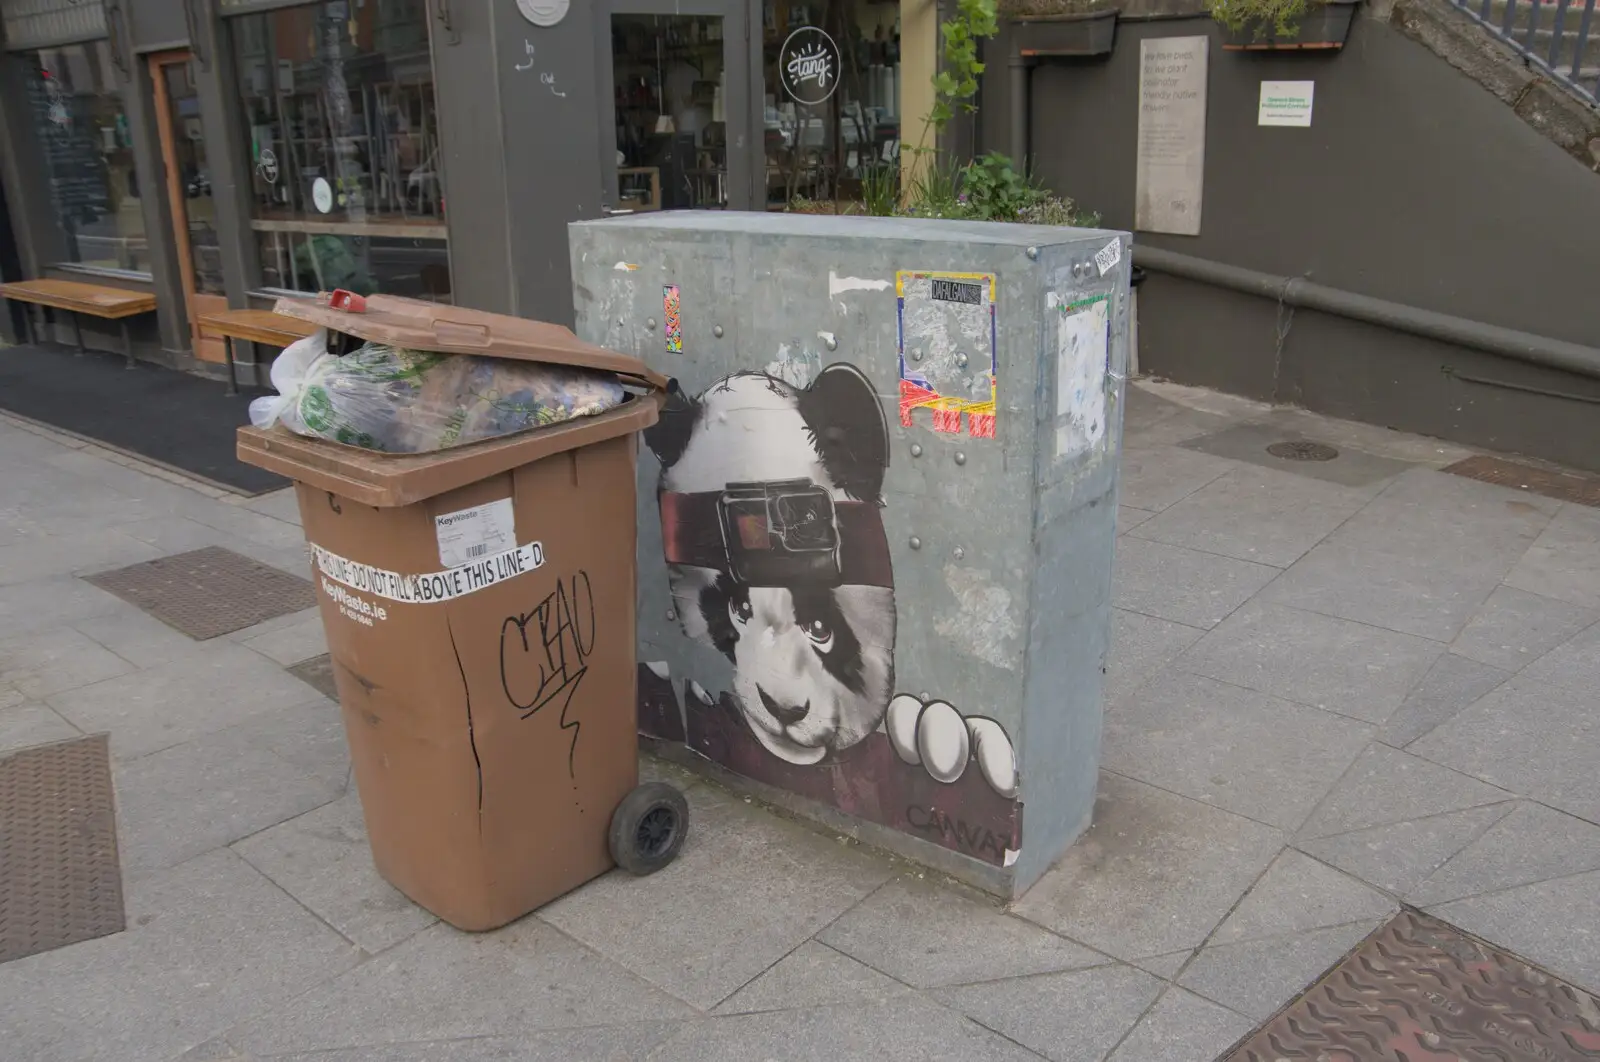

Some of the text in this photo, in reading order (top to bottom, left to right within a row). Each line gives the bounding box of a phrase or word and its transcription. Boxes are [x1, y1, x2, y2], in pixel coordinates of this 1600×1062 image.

[437, 511, 478, 527] KeyWaste
[321, 576, 388, 621] KeyWaste.ie
[366, 567, 387, 595] NOT
[413, 571, 462, 601] ABOVE
[463, 560, 495, 590] THIS
